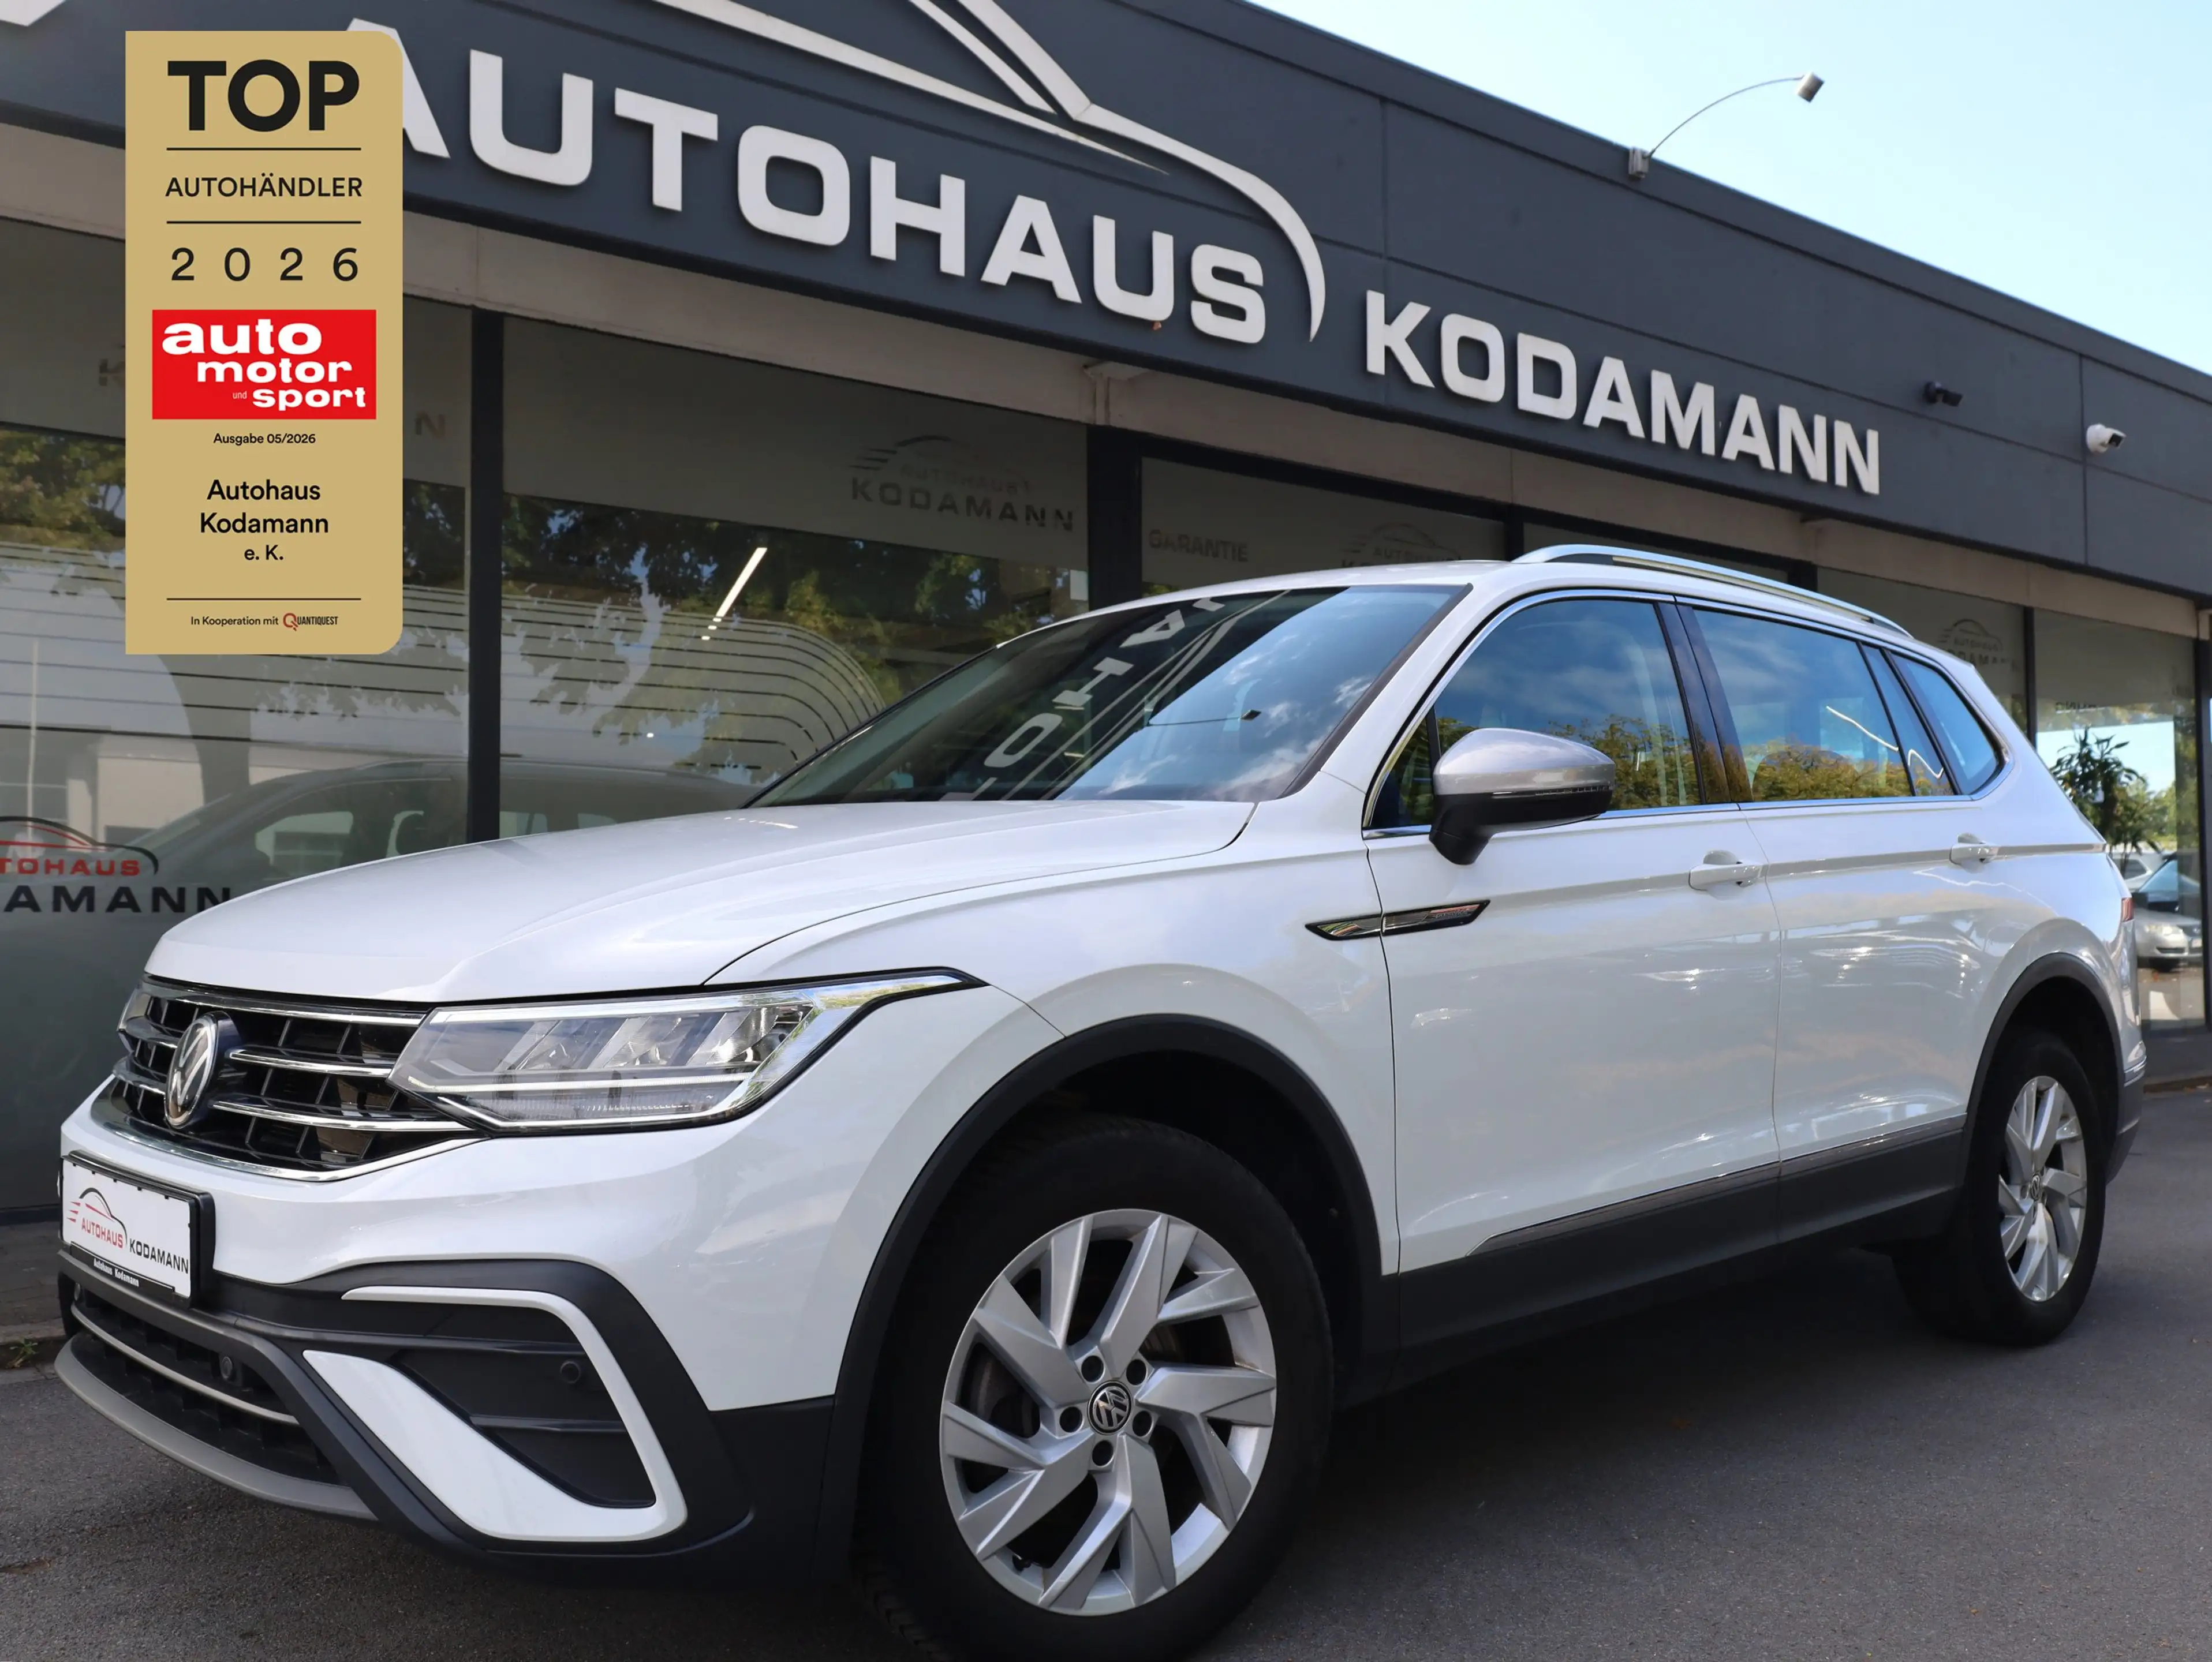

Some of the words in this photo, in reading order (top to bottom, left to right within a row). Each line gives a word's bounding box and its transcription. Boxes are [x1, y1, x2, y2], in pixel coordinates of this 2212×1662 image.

[1366, 289, 1880, 496] KODAMANN
[851, 477, 1074, 531] KODAMANN
[1148, 529, 1249, 562] GARANTIE
[81, 1217, 124, 1249] AUTOHAUS
[129, 1238, 189, 1274] KODAMANN
[94, 1257, 113, 1275] Autohaus
[115, 1268, 139, 1287] Kodamann
